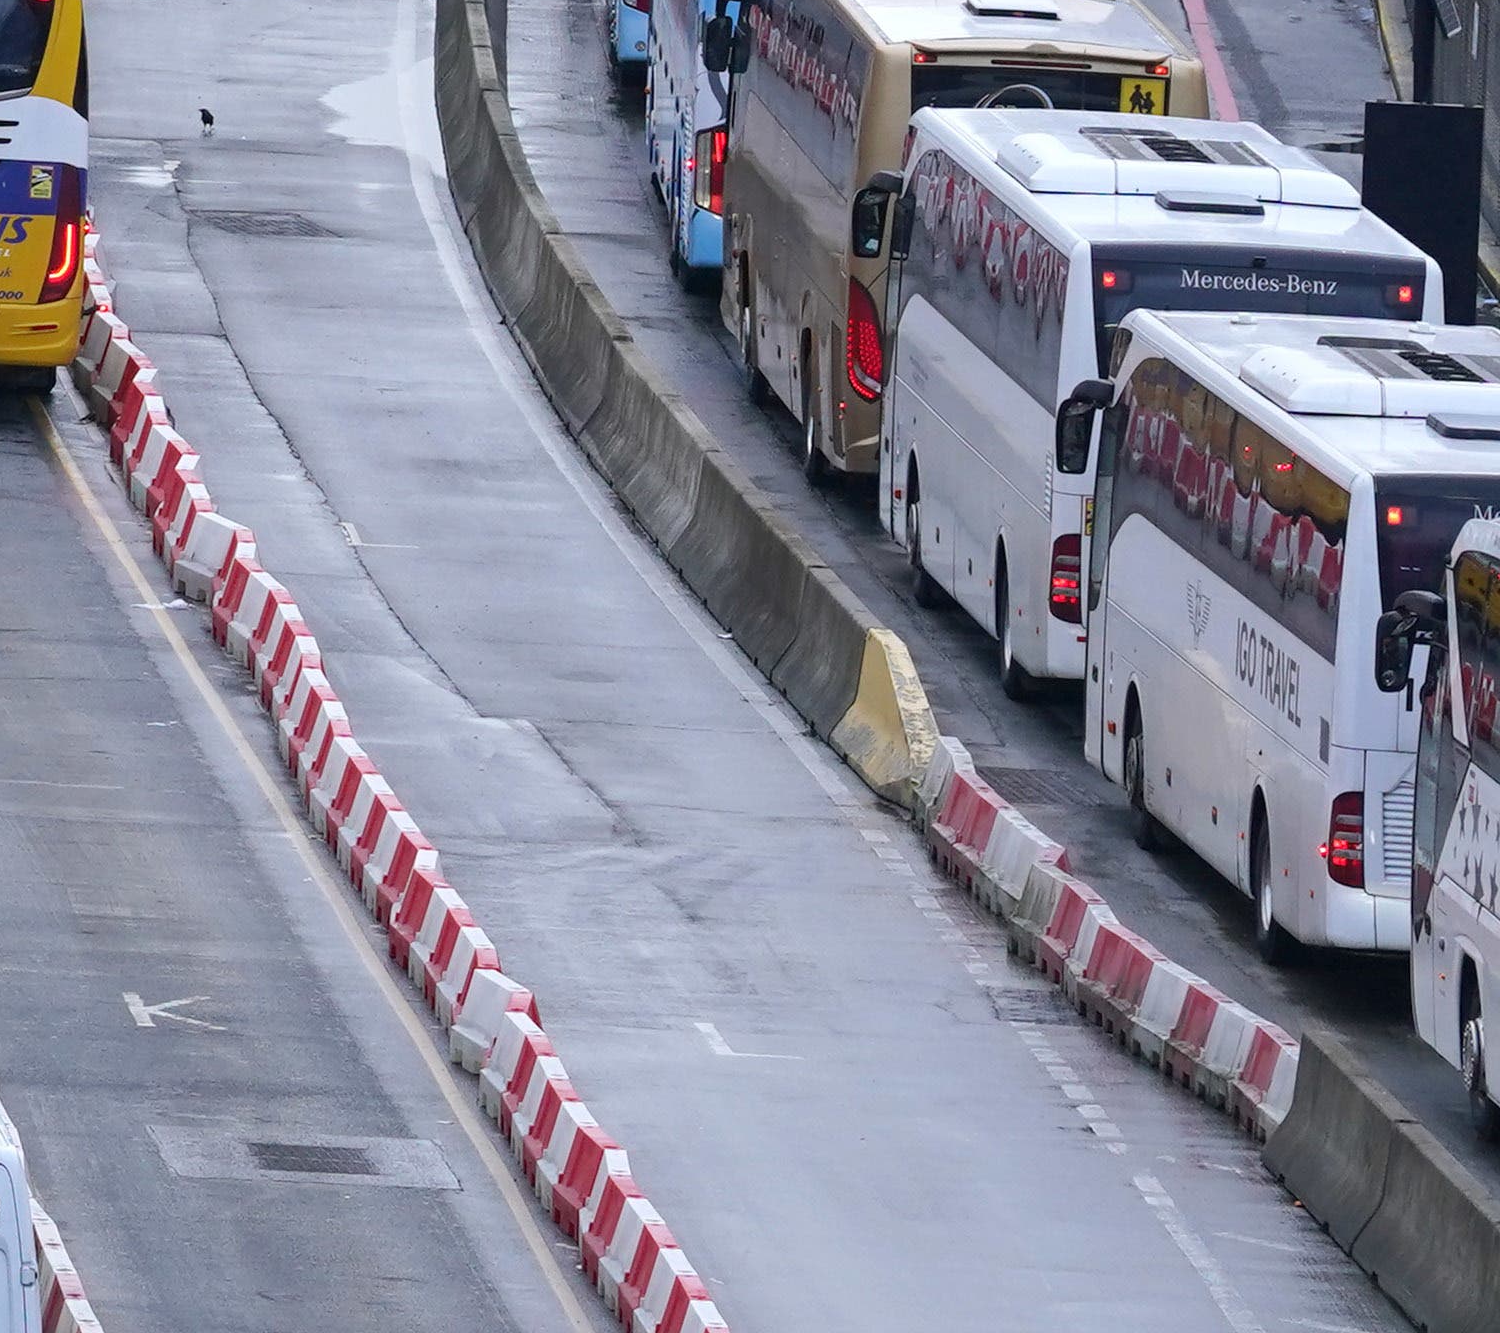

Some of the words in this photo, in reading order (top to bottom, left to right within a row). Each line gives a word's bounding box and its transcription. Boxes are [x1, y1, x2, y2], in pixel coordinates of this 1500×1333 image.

[1179, 269, 1339, 296] Mercedes-Benz
[1235, 618, 1257, 688] IGO
[1259, 635, 1302, 728] TRAVEL
